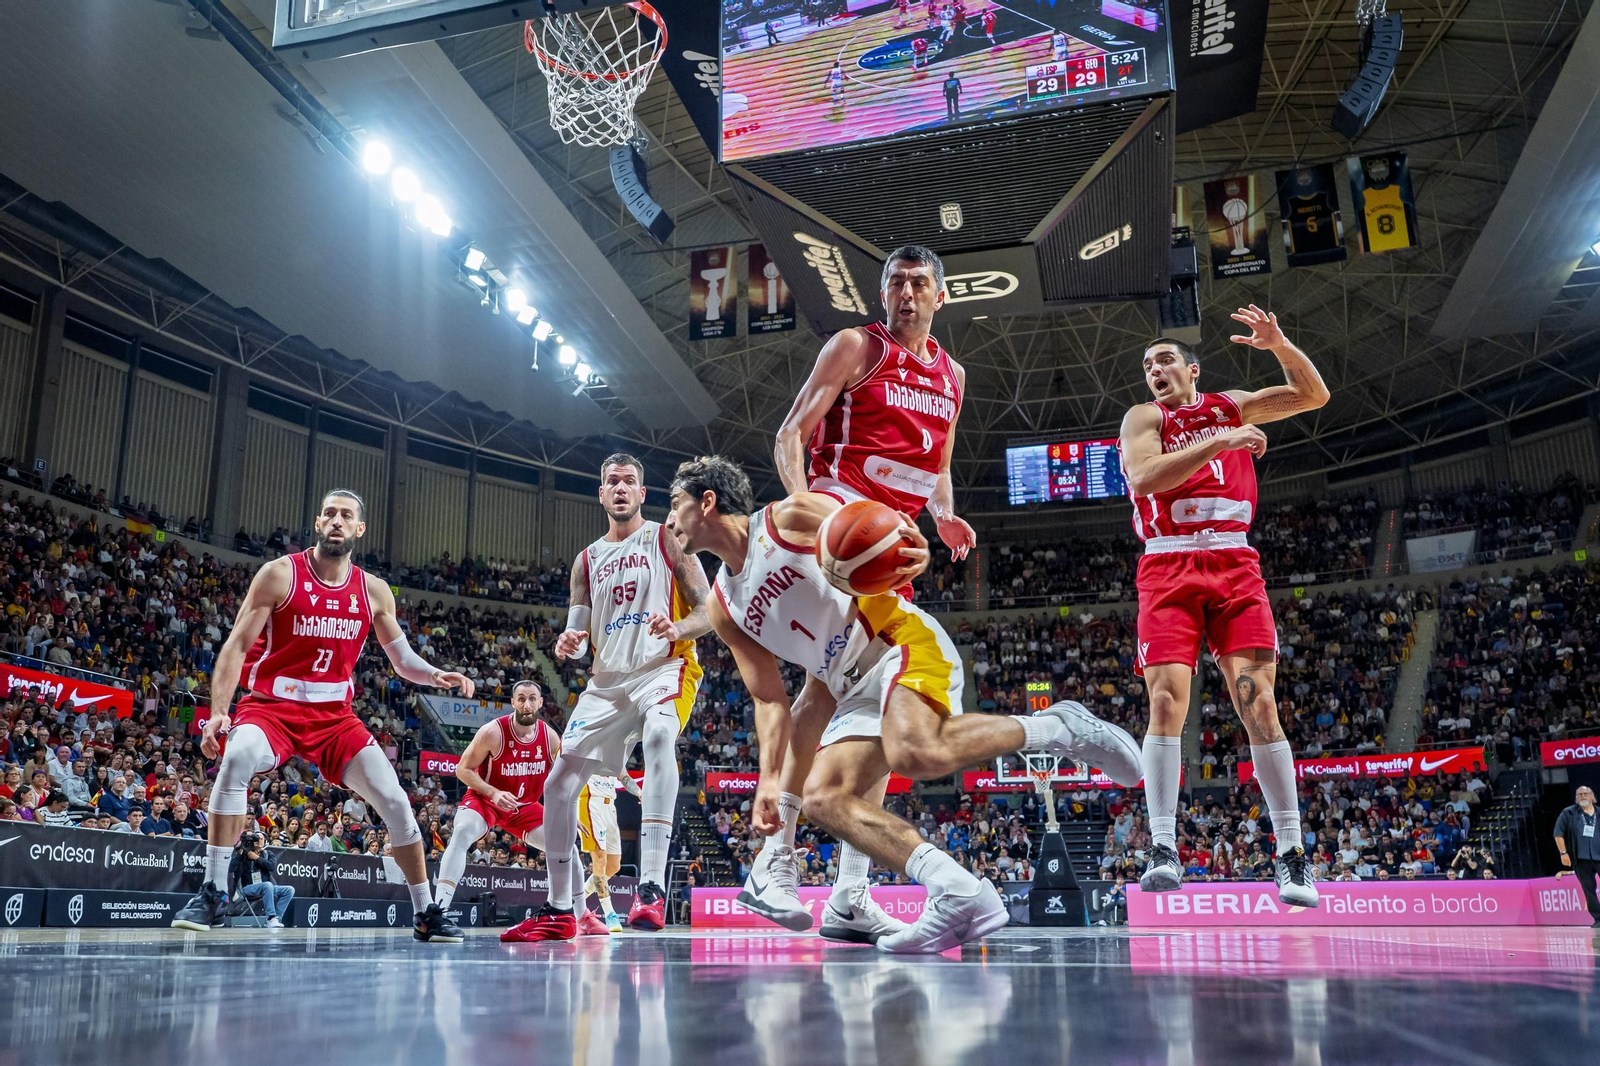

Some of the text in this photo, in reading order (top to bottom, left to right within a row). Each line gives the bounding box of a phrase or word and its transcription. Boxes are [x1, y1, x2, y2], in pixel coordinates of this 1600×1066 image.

[1085, 58, 1098, 70] GEO
[1111, 52, 1139, 65] 5:24
[1045, 65, 1058, 75] ESP
[1118, 65, 1132, 76] 2T
[1036, 78, 1059, 94] 29
[1075, 71, 1098, 88] 29
[1376, 213, 1396, 235] 8
[1217, 259, 1266, 270] SUBCAMPEONATO
[921, 427, 933, 455] 9
[1058, 475, 1077, 485] 05:24
[1208, 459, 1225, 485] 4
[595, 552, 650, 584] ESPAÑA
[612, 580, 637, 606] 35
[743, 565, 806, 638] ESPAÑA
[292, 614, 362, 640] საქართველო
[790, 619, 816, 642] 1
[311, 647, 334, 673] 23
[1026, 682, 1051, 692] 05:24
[453, 702, 479, 715] DXT
[1029, 695, 1050, 711] 10
[1315, 763, 1354, 775] CaixaBank
[1365, 756, 1414, 771] tenerife!
[517, 781, 526, 799] 6
[29, 841, 95, 864] endesa
[124, 851, 169, 868] CaixaBank
[276, 861, 319, 878] endesa
[337, 867, 368, 881] CaixaBank
[101, 900, 171, 911] SELECCIÓN ESPAÑOLA
[1155, 893, 1280, 915] IBERIA
[1319, 892, 1498, 914] Talento a bordo
[1538, 888, 1582, 912] IBERIA
[330, 909, 377, 922] #LaFamilia
